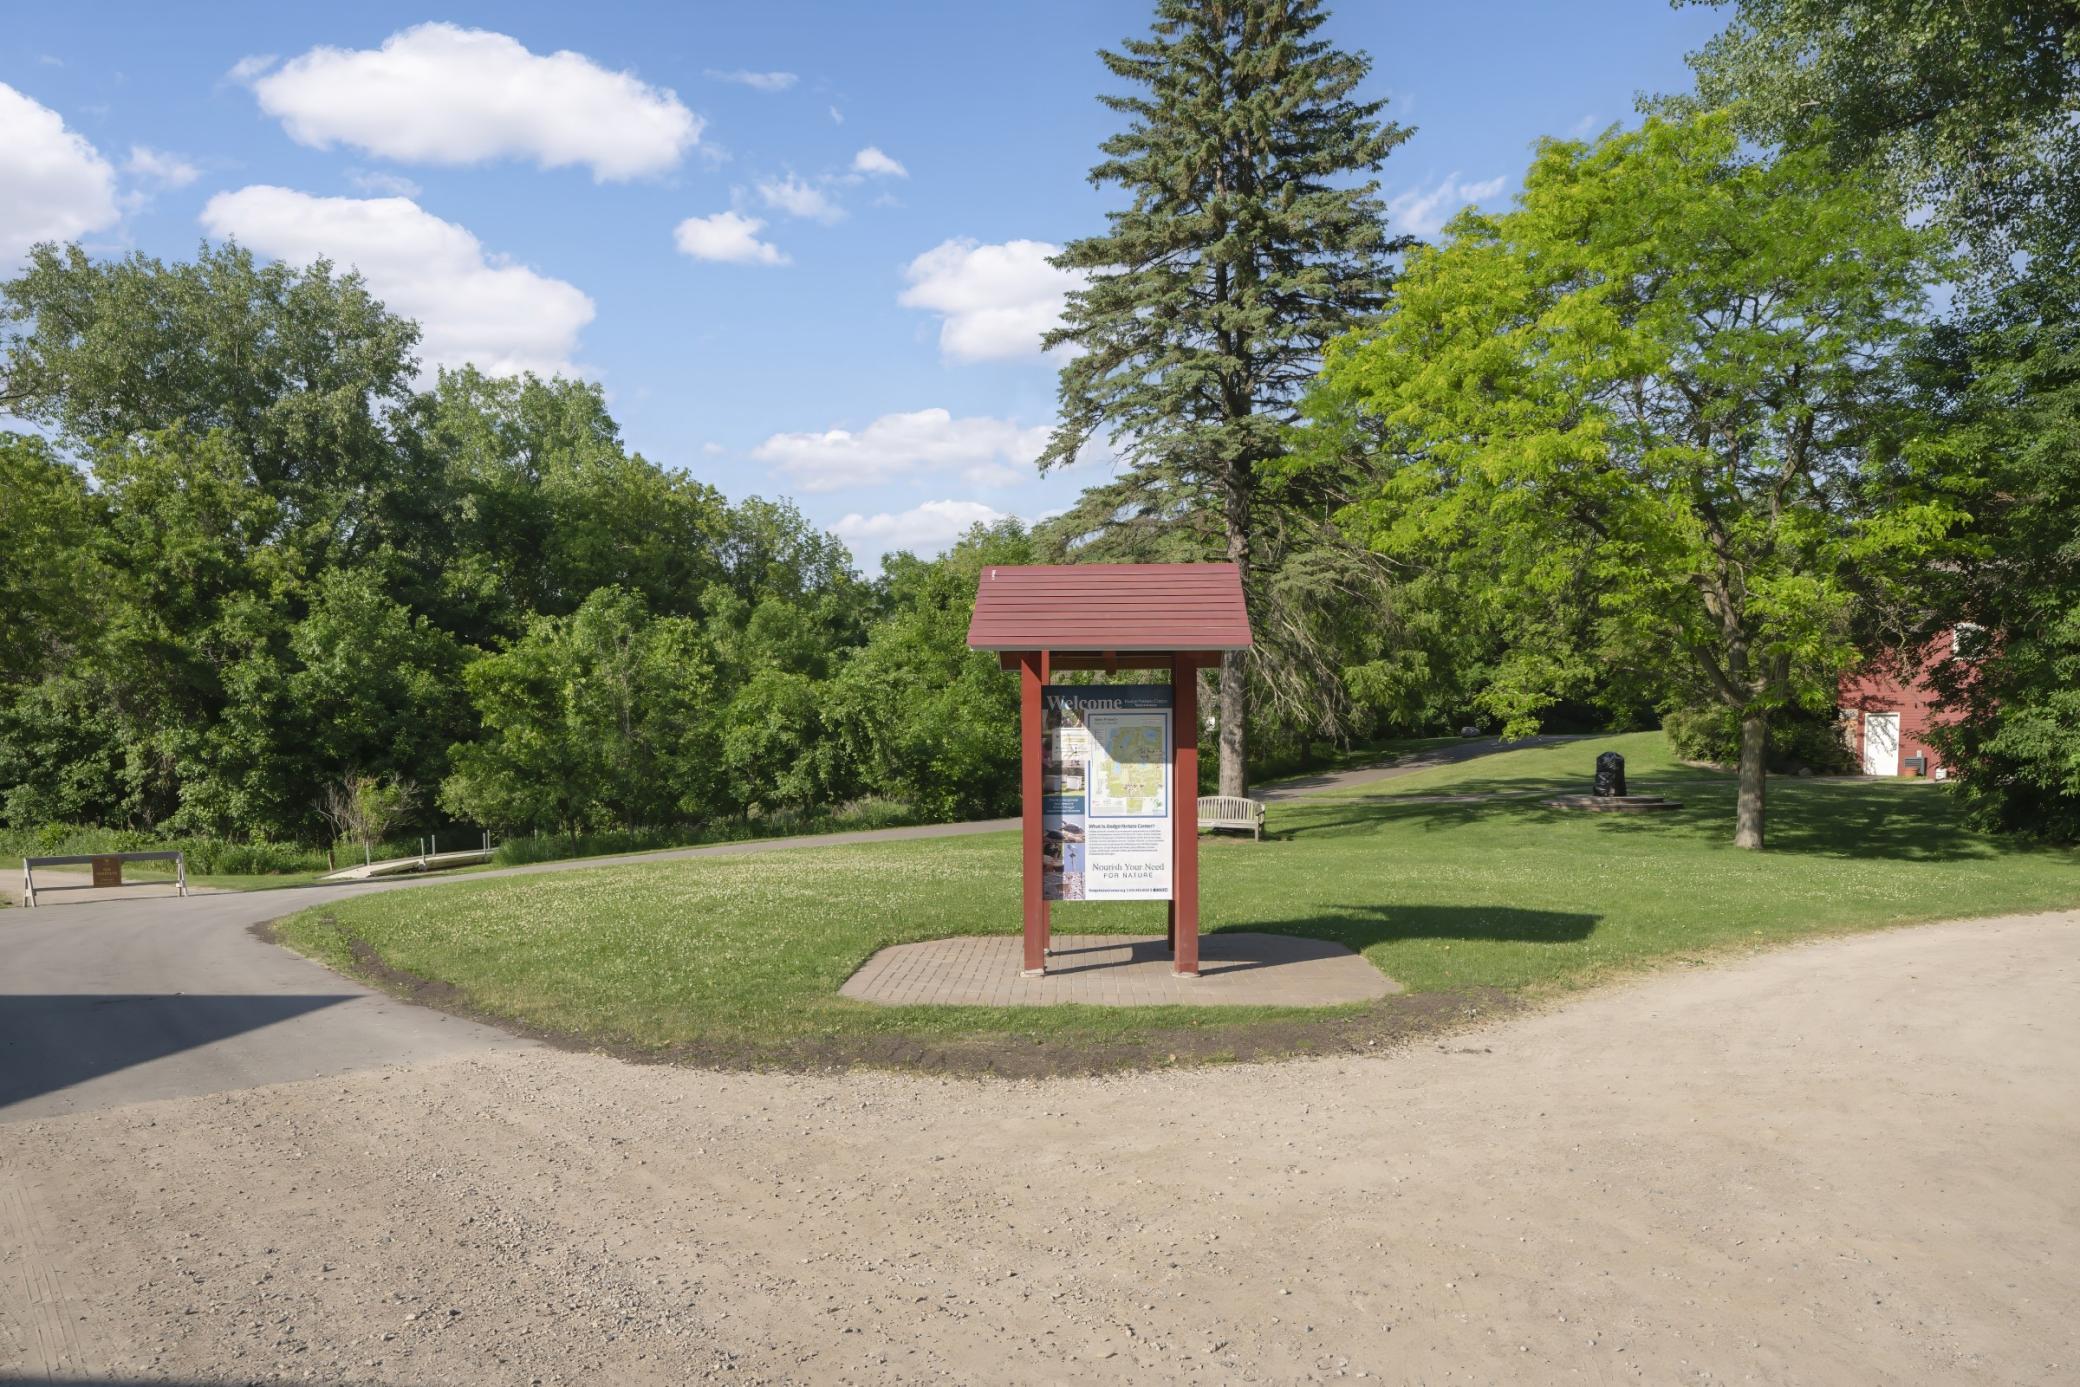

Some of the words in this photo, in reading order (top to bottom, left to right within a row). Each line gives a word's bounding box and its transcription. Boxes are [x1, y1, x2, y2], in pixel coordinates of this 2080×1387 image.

[1047, 695, 1123, 710] Welcome
[1092, 863, 1122, 871] Nourish
[1124, 863, 1142, 871] Your
[1145, 863, 1165, 871] Need
